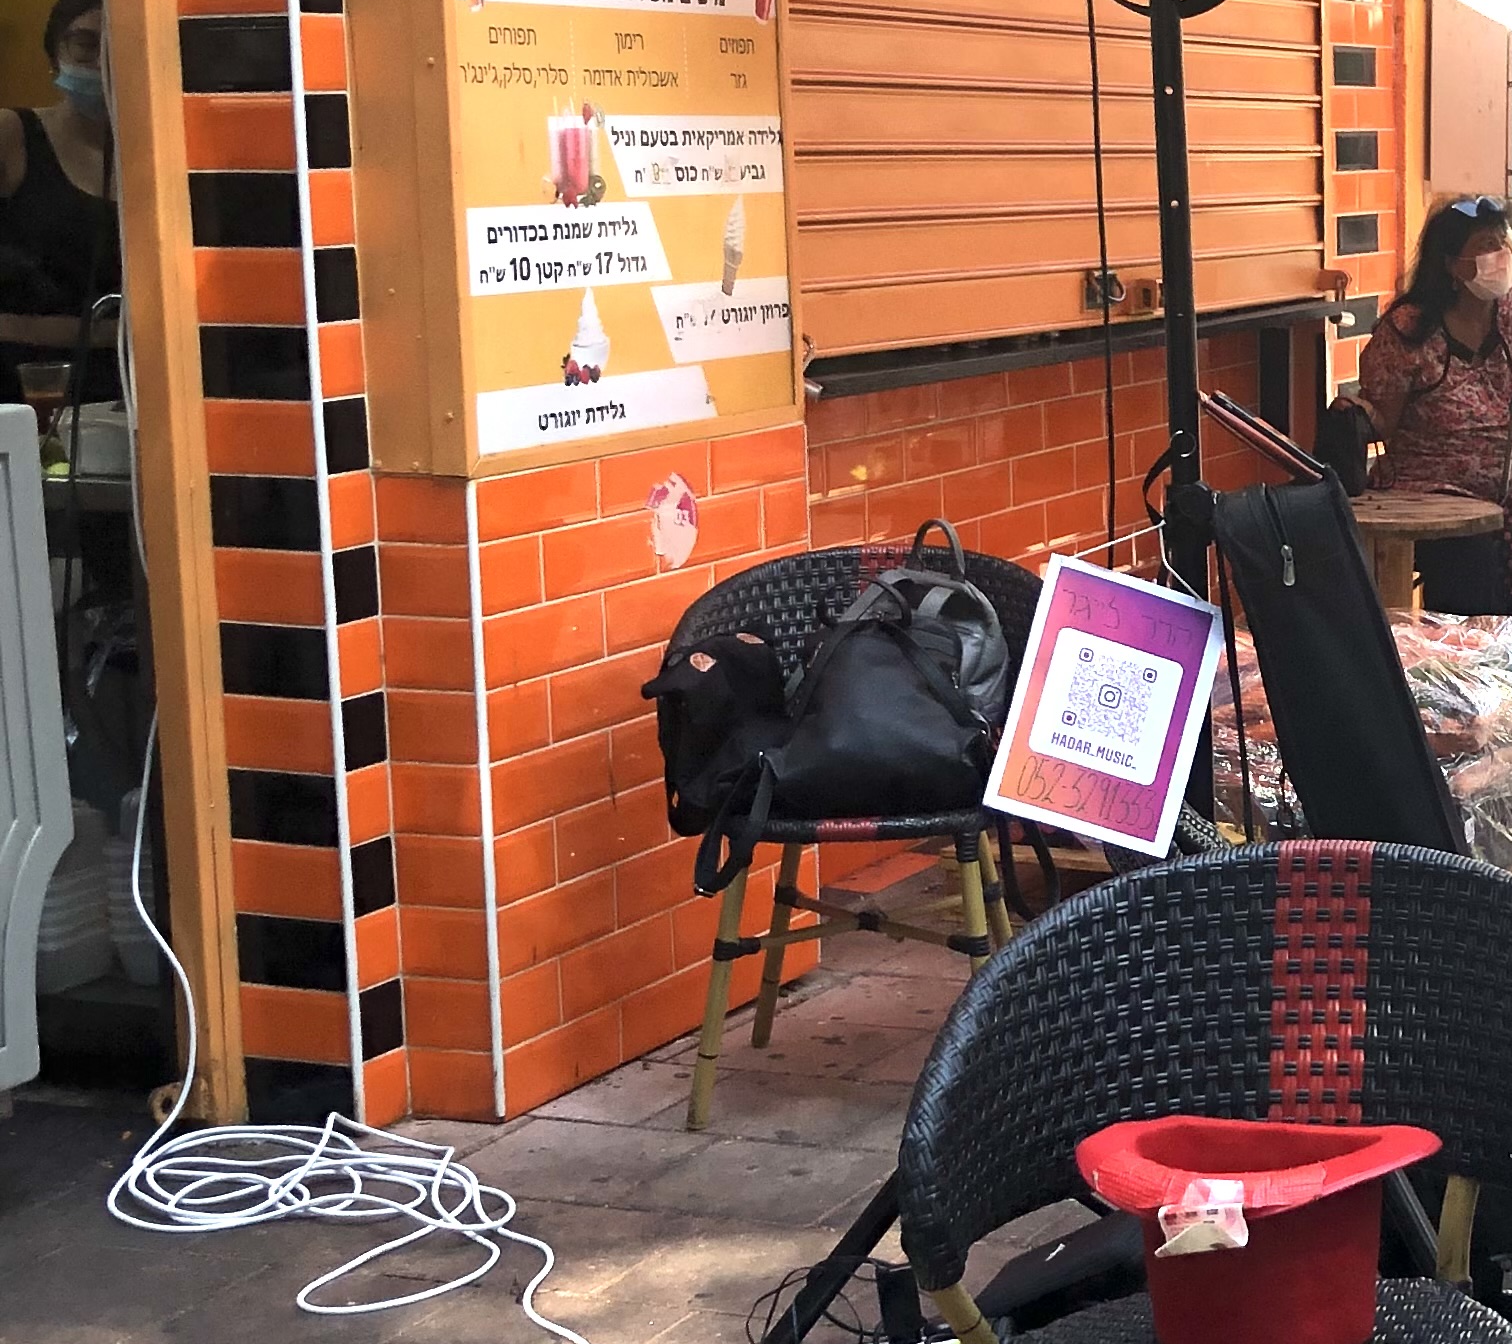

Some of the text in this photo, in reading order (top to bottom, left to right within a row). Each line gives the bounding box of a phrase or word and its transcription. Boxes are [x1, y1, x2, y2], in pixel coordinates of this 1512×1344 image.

[488, 25, 537, 46] תפוחים
[615, 31, 645, 54] רימון
[720, 37, 755, 55] תפוזים
[583, 67, 679, 88] אשכולית אדומה
[730, 72, 748, 90] גזר
[611, 126, 636, 147] וניל
[641, 130, 678, 147] בטעם
[681, 129, 745, 150] אמריקאית
[675, 165, 698, 182] כוס
[740, 164, 766, 181] גביע
[487, 216, 637, 244] גלידת שמנת בכדורים
[479, 251, 647, 284] גדול 17 ש"ח קטן 10 ש"ח
[721, 306, 757, 324] יוגורט
[760, 303, 790, 325] פרוזן
[538, 400, 626, 431] גלידת יוגורט
